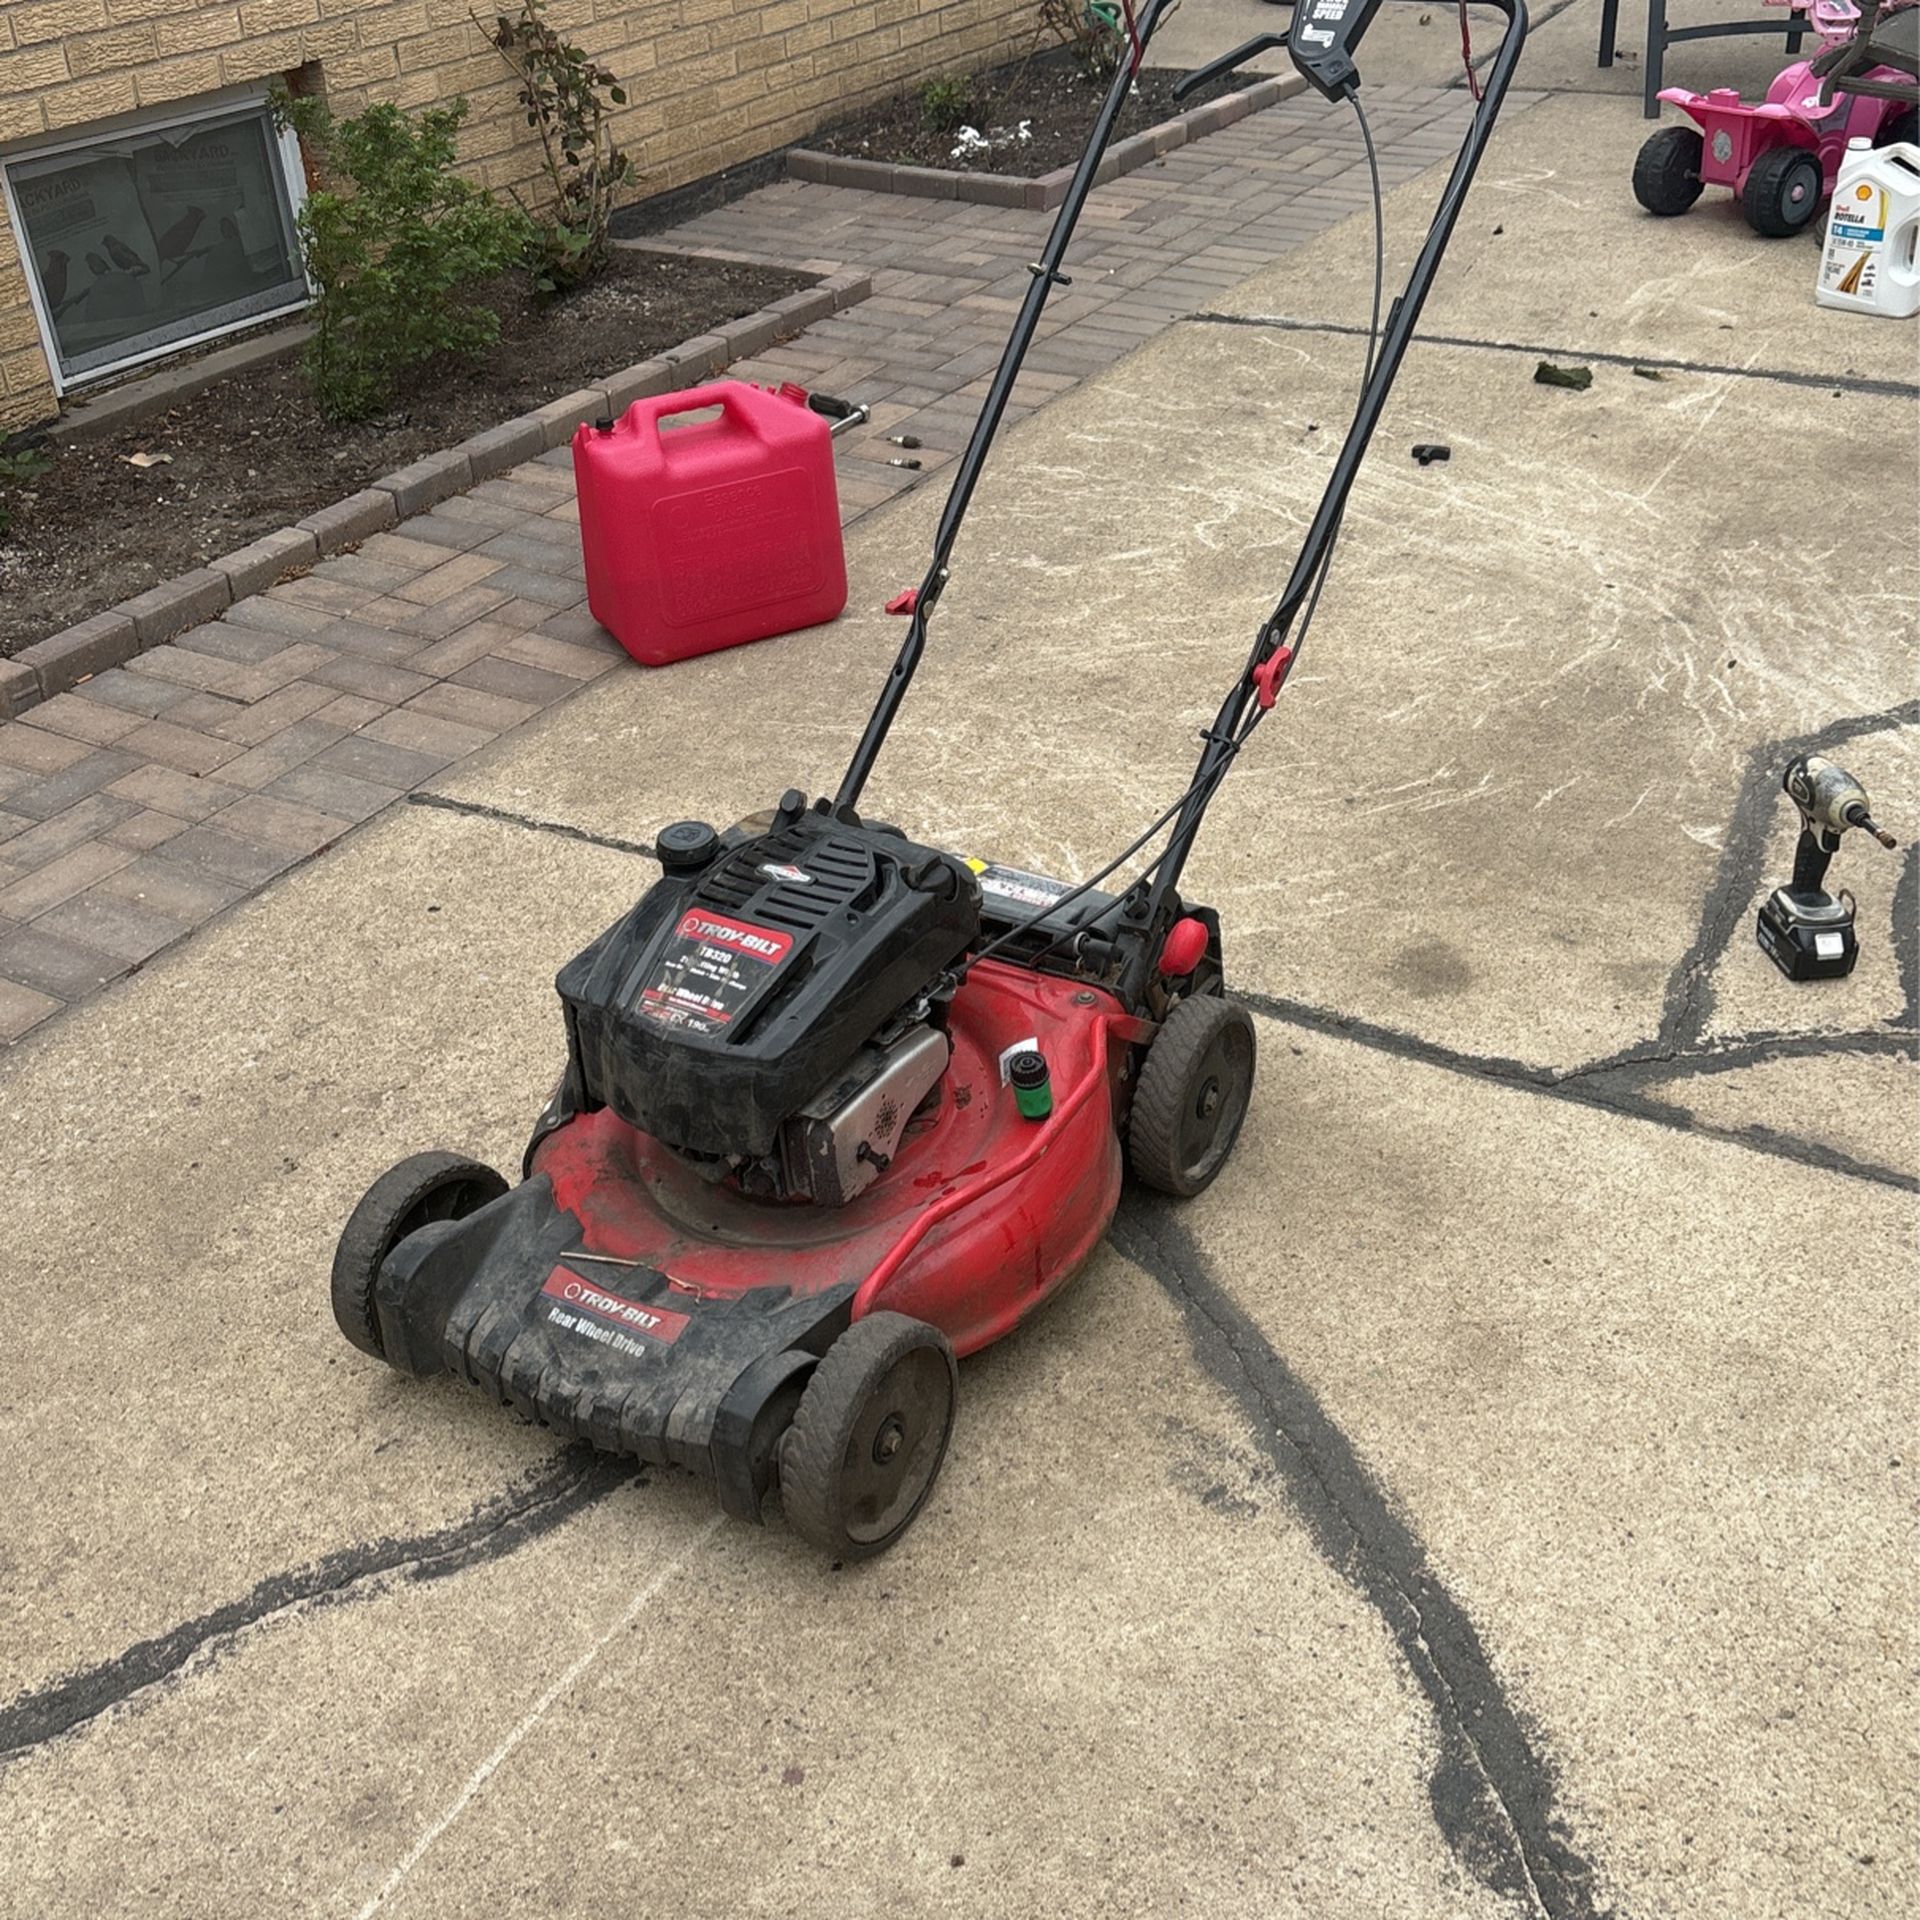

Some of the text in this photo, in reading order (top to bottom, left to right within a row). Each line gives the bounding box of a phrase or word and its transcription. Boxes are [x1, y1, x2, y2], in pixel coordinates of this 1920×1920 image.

[1312, 9, 1344, 20] SPEED
[1834, 213, 1865, 223] ROTELLA
[698, 922, 781, 955] TROY-BILT
[699, 946, 733, 964] TB320
[579, 1289, 661, 1328] TROY-BILT
[548, 1307, 645, 1358] Rear Wheel Drive
